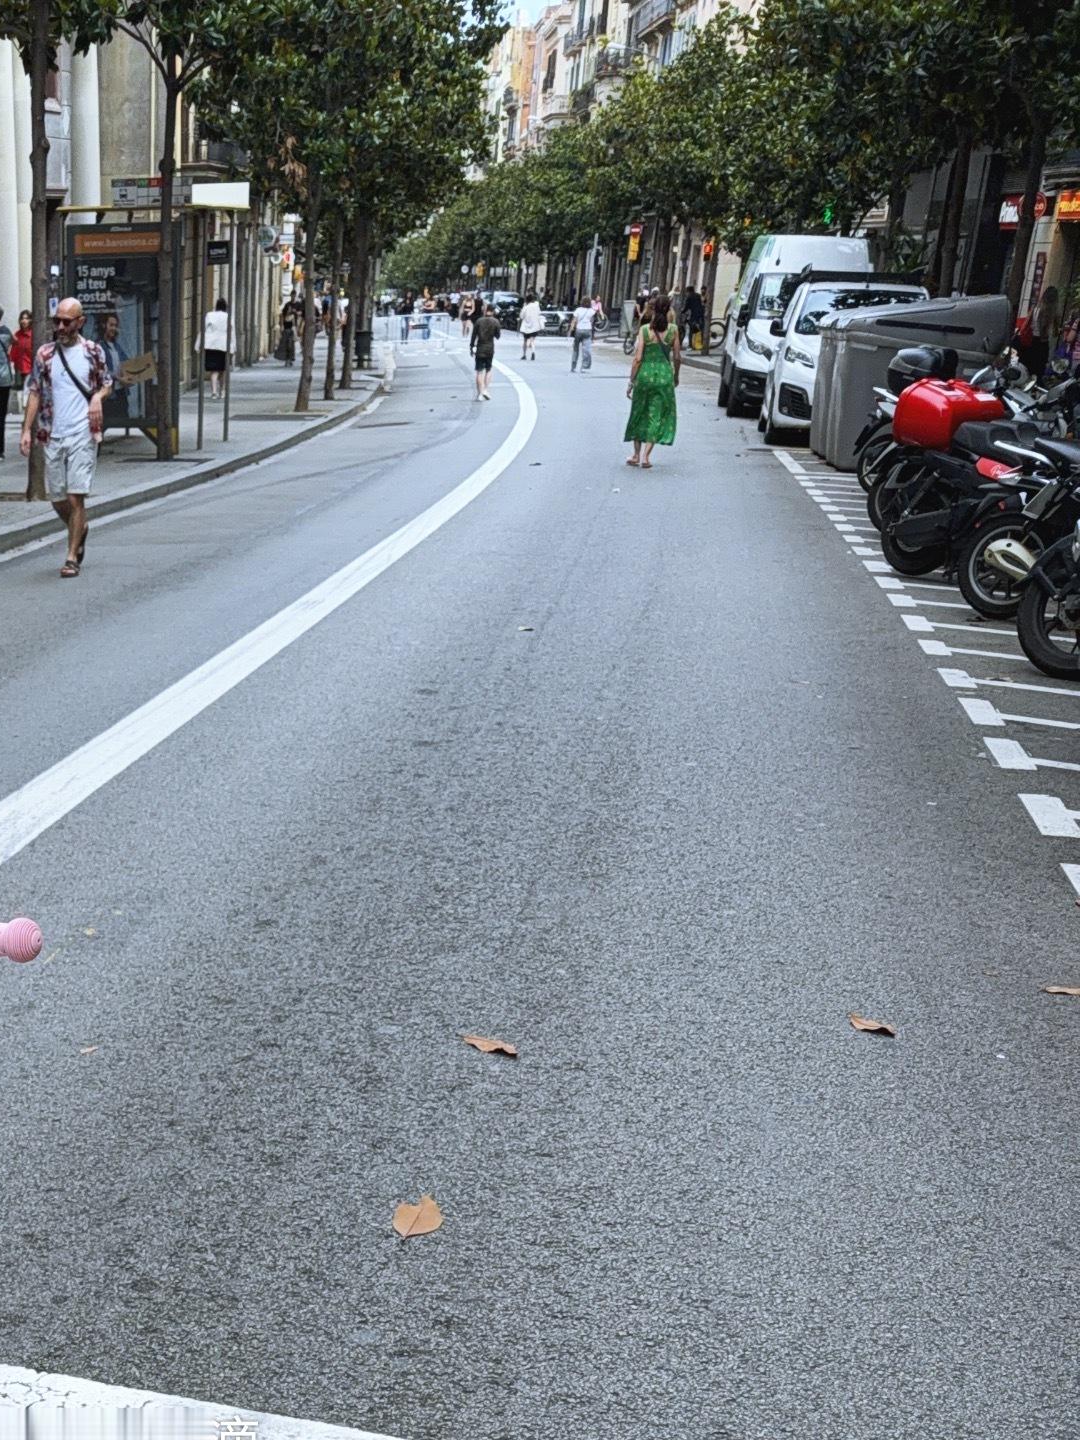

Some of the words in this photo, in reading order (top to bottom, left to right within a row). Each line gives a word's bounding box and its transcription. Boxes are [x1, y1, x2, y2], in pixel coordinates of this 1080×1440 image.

[77, 266, 89, 277] 15
[90, 266, 116, 279] anys
[76, 279, 87, 289] al
[88, 279, 106, 289] teu
